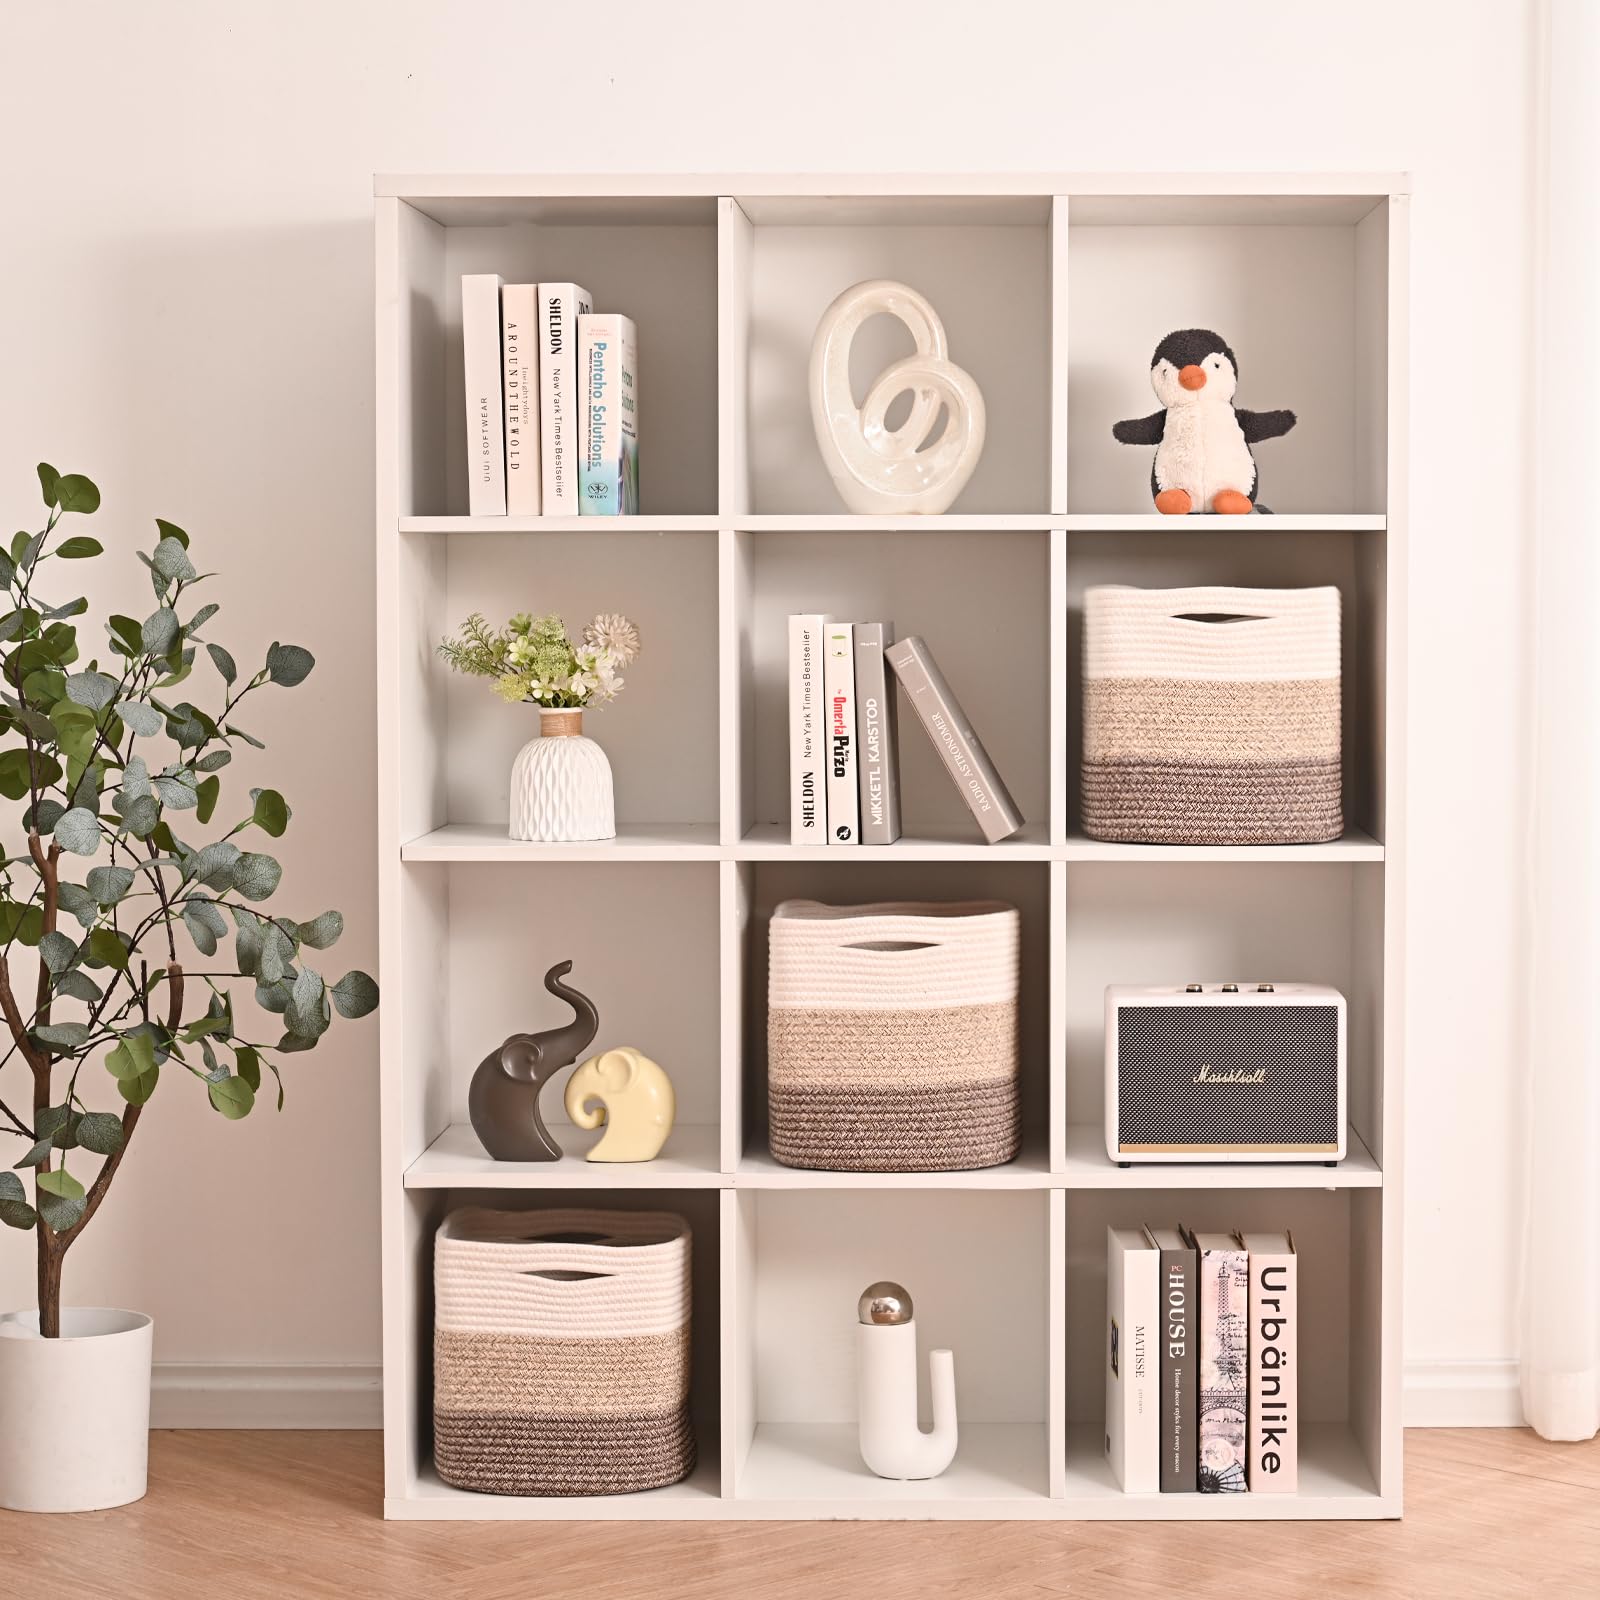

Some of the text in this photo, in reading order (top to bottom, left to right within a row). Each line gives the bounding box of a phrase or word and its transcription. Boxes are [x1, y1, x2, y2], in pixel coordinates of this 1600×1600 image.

[549, 298, 562, 355] SHELDON
[593, 342, 607, 399] Pentaho
[481, 397, 490, 455] SOFTWEAR
[592, 405, 607, 468] Solutions
[803, 682, 811, 711] Times
[833, 696, 847, 735] Omerta
[803, 737, 812, 758] New
[833, 735, 849, 778] Puzo
[866, 698, 882, 825] MIKKETL KARSTOD
[931, 711, 974, 778] ASTRONOMER
[803, 771, 814, 828] SHELDON
[968, 779, 991, 812] RADIO
[1169, 1274, 1186, 1359] HOUSE
[1135, 1326, 1145, 1378] MATISSE
[1174, 1368, 1182, 1389] Home
[1260, 1266, 1288, 1474] Urbänlike
[1174, 1389, 1182, 1407] decor
[1173, 1435, 1181, 1452] every
